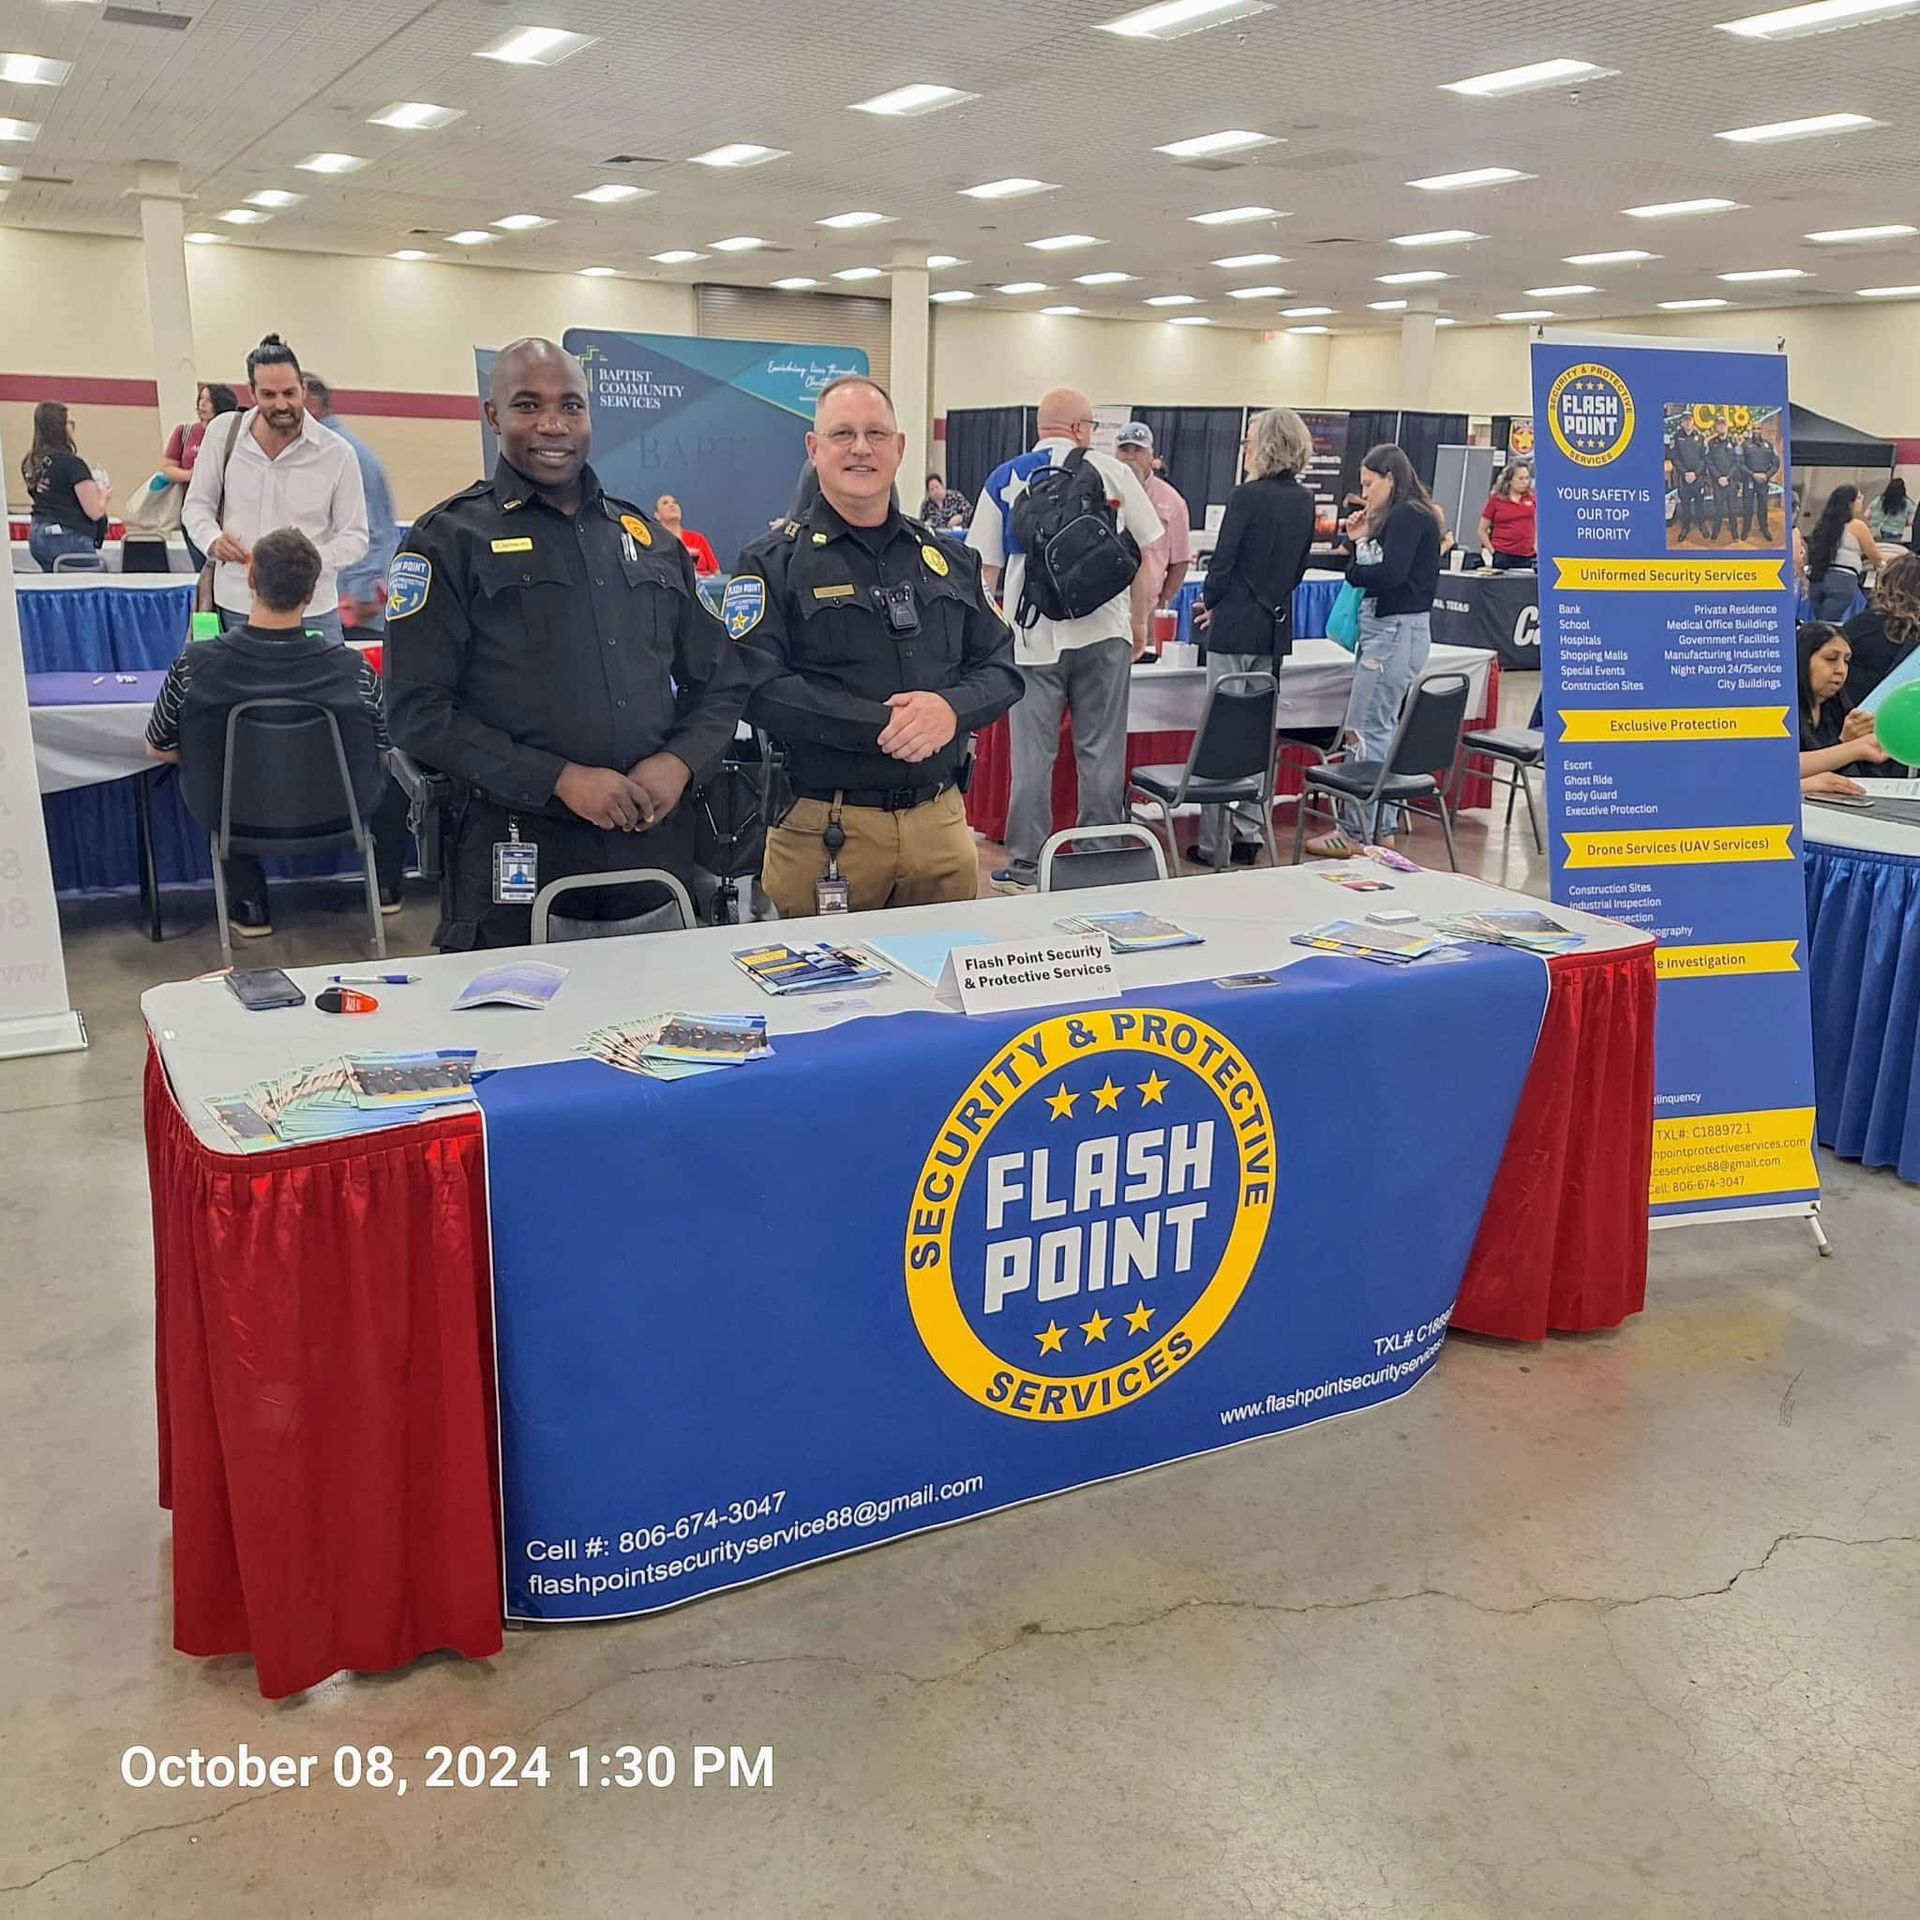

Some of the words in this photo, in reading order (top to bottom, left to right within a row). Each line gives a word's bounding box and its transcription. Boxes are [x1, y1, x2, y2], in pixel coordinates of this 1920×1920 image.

[599, 368, 653, 382] BAPTIST
[599, 381, 684, 398] COMMUNITY
[1550, 368, 1577, 410] SECURITY
[1590, 366, 1632, 413] PROTECTIVE
[600, 395, 661, 409] SERVICES
[1562, 394, 1618, 415] FLASH
[1563, 415, 1618, 436] POINT
[1569, 450, 1613, 465] SERVICES
[1557, 488, 1589, 501] YOUR
[1592, 489, 1637, 502] SAFETY
[1639, 489, 1651, 502] IS
[1576, 507, 1603, 521] OUR
[1604, 508, 1630, 521] TOP
[1576, 528, 1631, 540] PRIORITY
[1580, 568, 1646, 582] Uniformed
[1649, 568, 1701, 584] Security
[1704, 569, 1757, 582] Services
[1446, 601, 1470, 613] TEXAS
[1558, 604, 1581, 614] Bank
[1694, 605, 1728, 615] Private
[1729, 604, 1778, 614] Residence
[1559, 619, 1590, 630] School
[1666, 620, 1703, 630] Medical
[1705, 620, 1733, 629] Office
[1735, 619, 1778, 630] Buildings
[1560, 635, 1602, 647] Hospitals
[1679, 635, 1737, 645] Government
[1739, 633, 1780, 644] Facilities
[1560, 650, 1603, 662] Shopping
[1604, 650, 1628, 661] Malls
[1664, 649, 1732, 661] Manufacturing
[1733, 648, 1780, 659] Industries
[1561, 666, 1593, 677] Special
[1595, 666, 1625, 676] Events
[1670, 665, 1696, 677] Night
[1698, 665, 1726, 674] Patrol
[1561, 680, 1620, 691] Construction
[1621, 680, 1644, 691] Sites
[1717, 679, 1737, 690] City
[1738, 678, 1781, 690] Buildings
[1610, 719, 1667, 732] Exclusive
[1670, 718, 1737, 731] Protection
[1563, 760, 1592, 770] Escort
[1564, 775, 1591, 785] Ghost
[1592, 774, 1613, 785] Ride
[1565, 790, 1588, 802] Body
[1590, 789, 1617, 800] Guard
[1565, 805, 1609, 816] Executive
[1610, 803, 1658, 815] Protection
[1587, 844, 1623, 856] Drone
[1626, 841, 1677, 855] Services
[1679, 839, 1712, 853] (UAV
[1713, 837, 1769, 852] Services)
[1568, 884, 1628, 896] Construction
[1629, 882, 1652, 893] Sites
[1569, 899, 1613, 911] Industrial
[1614, 897, 1662, 910] Inspection
[965, 955, 1004, 971] Flash
[1007, 951, 1044, 966] Point
[1046, 945, 1102, 961] Security
[1667, 954, 1746, 970] Investigation
[964, 977, 976, 990] &
[979, 969, 1051, 988] Protective
[1053, 963, 1112, 979] Services
[911, 1031, 1047, 1270] SECURITY
[1066, 1019, 1097, 1048] &
[1111, 1013, 1270, 1208] PROTECTIVE
[1656, 1128, 1690, 1141] TXL#:
[985, 1120, 1215, 1231] FLASH
[1672, 1176, 1745, 1193] 806-674-3047
[983, 1201, 1208, 1315] POINT
[1373, 1329, 1414, 1357] TXL#
[985, 1330, 1194, 1415] SERVICES
[525, 1538, 577, 1562] Cell
[584, 1536, 610, 1559] #:
[618, 1490, 787, 1555] 806-674-3047
[528, 1474, 984, 1597] flashpointsecurityservice88@gmail.com
